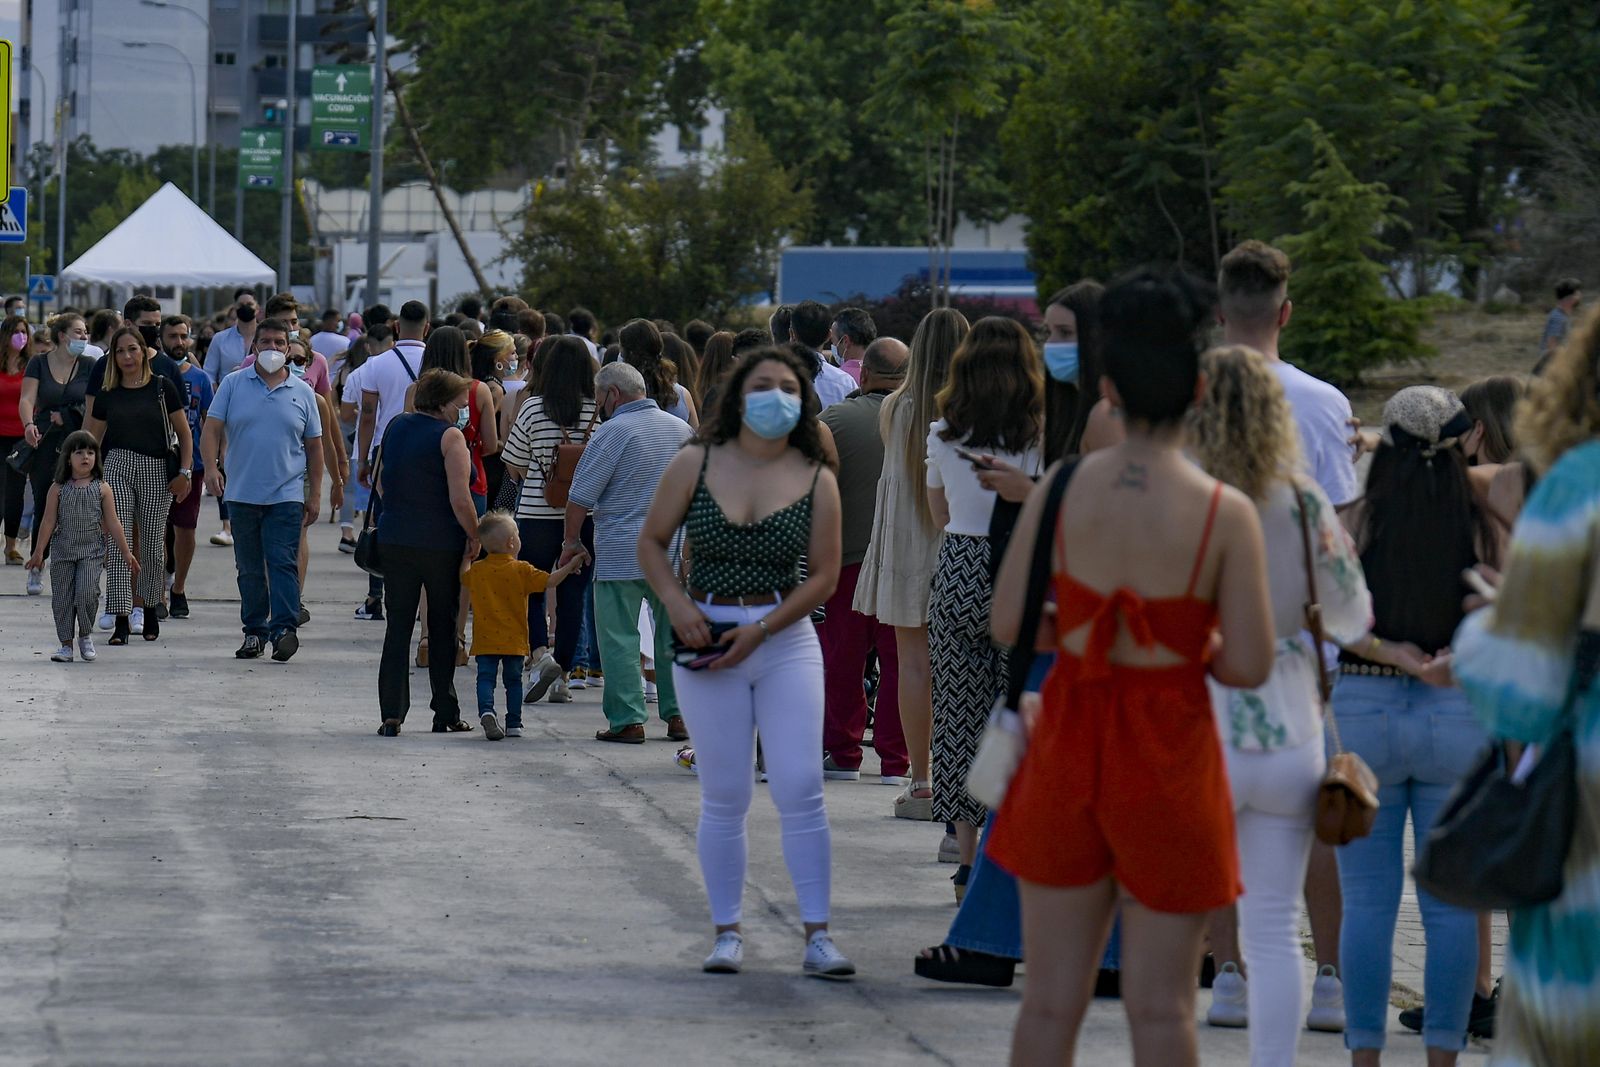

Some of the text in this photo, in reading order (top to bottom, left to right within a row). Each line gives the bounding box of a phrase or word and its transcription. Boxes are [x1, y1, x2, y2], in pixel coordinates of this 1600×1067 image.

[313, 93, 370, 103] VACUNACIÓN
[327, 103, 355, 112] COVID
[324, 131, 334, 144] P
